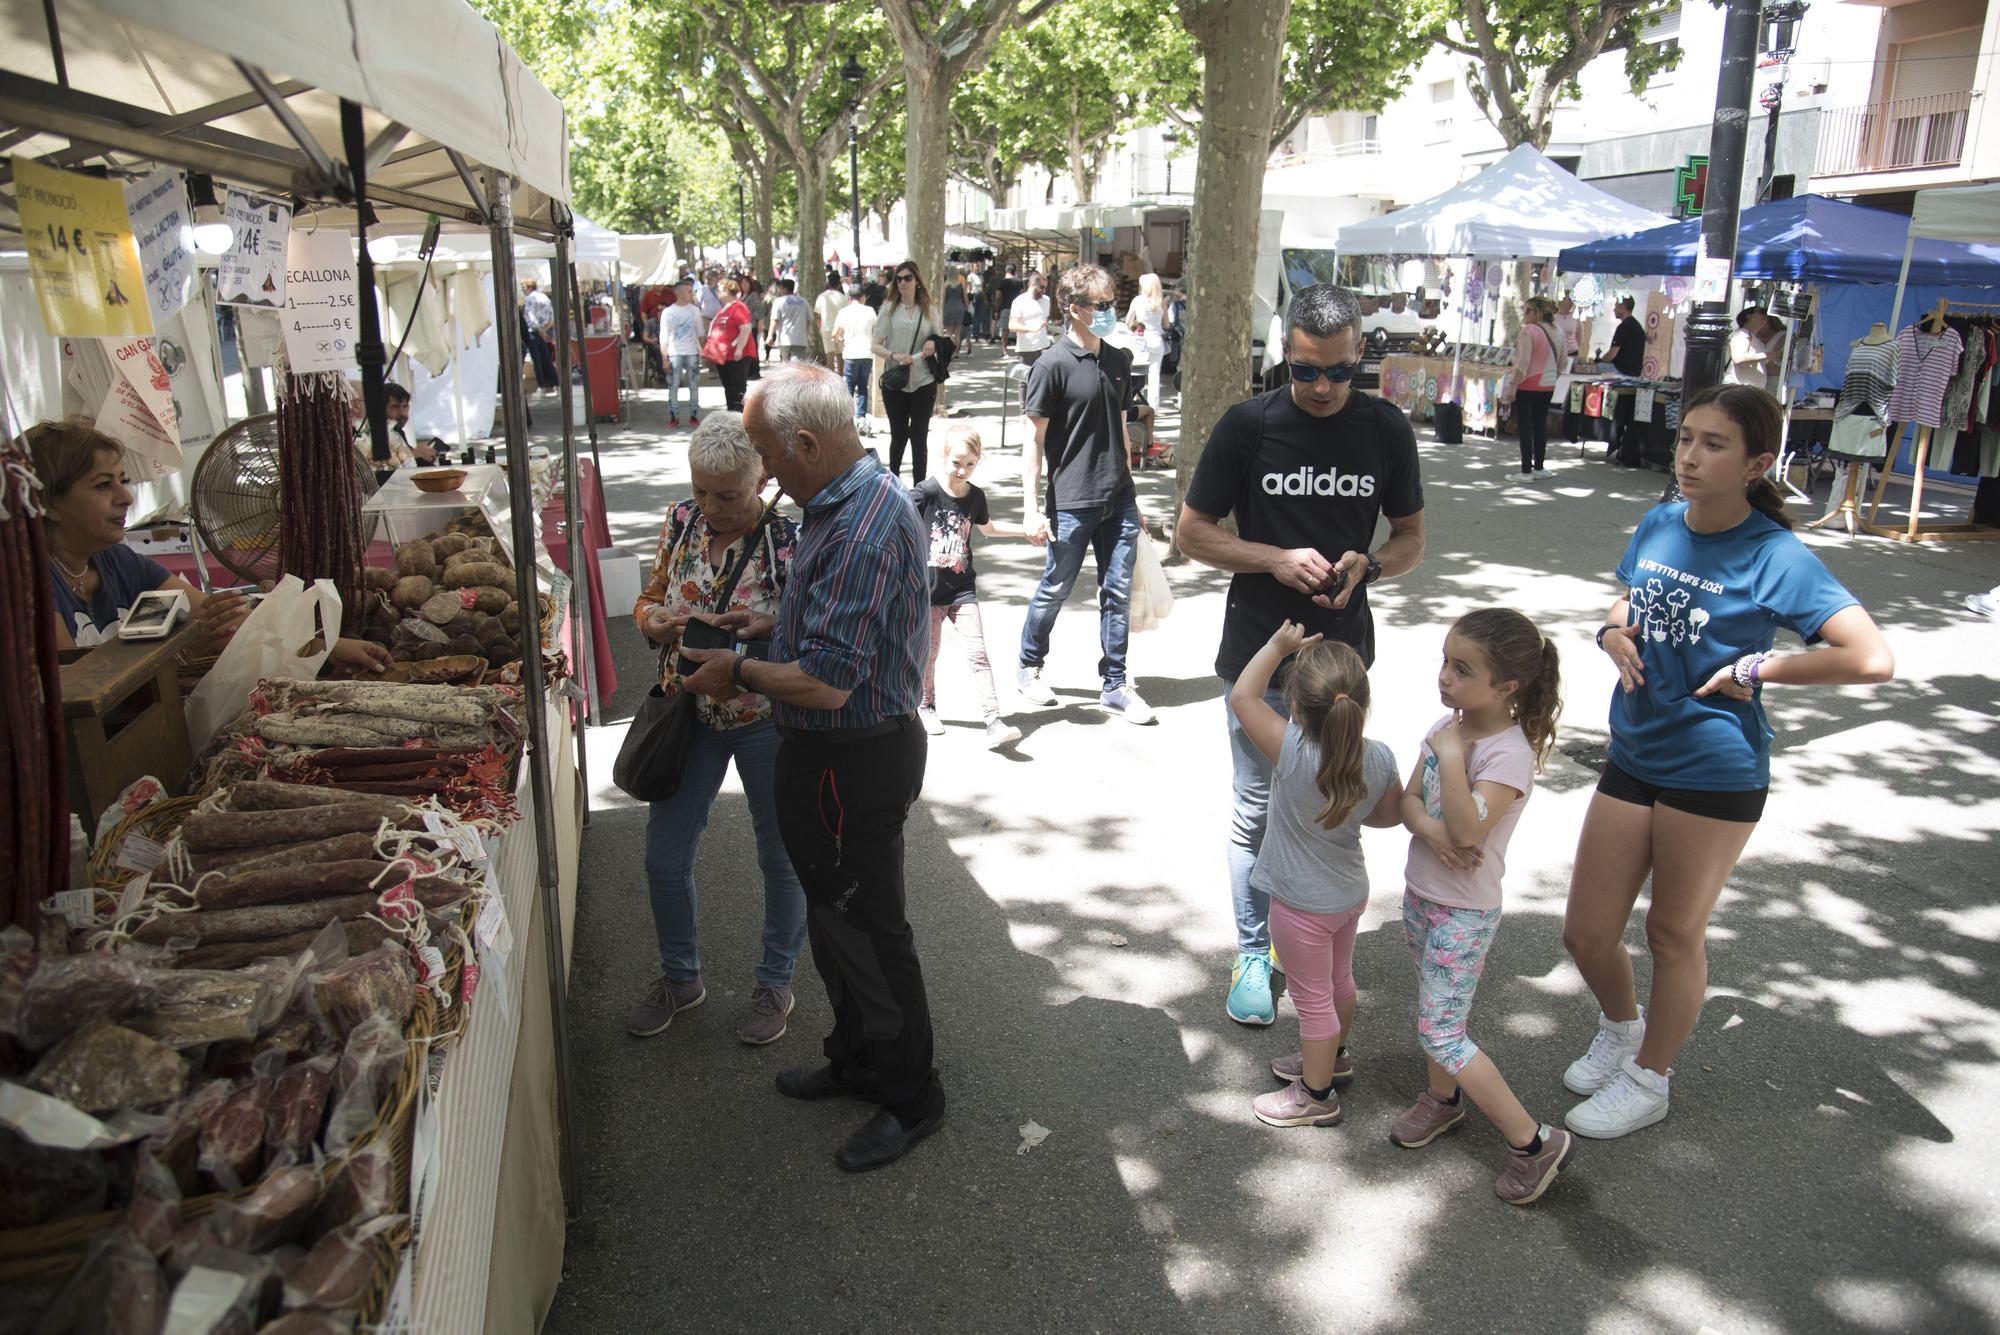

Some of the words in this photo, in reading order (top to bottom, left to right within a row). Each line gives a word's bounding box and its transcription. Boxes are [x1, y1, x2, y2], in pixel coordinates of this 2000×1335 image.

[48, 223, 69, 253] 14
[287, 269, 352, 283] ECALLONA
[116, 343, 138, 361] CAN
[1261, 466, 1376, 497] adidas
[1700, 579, 1725, 595] 2021
